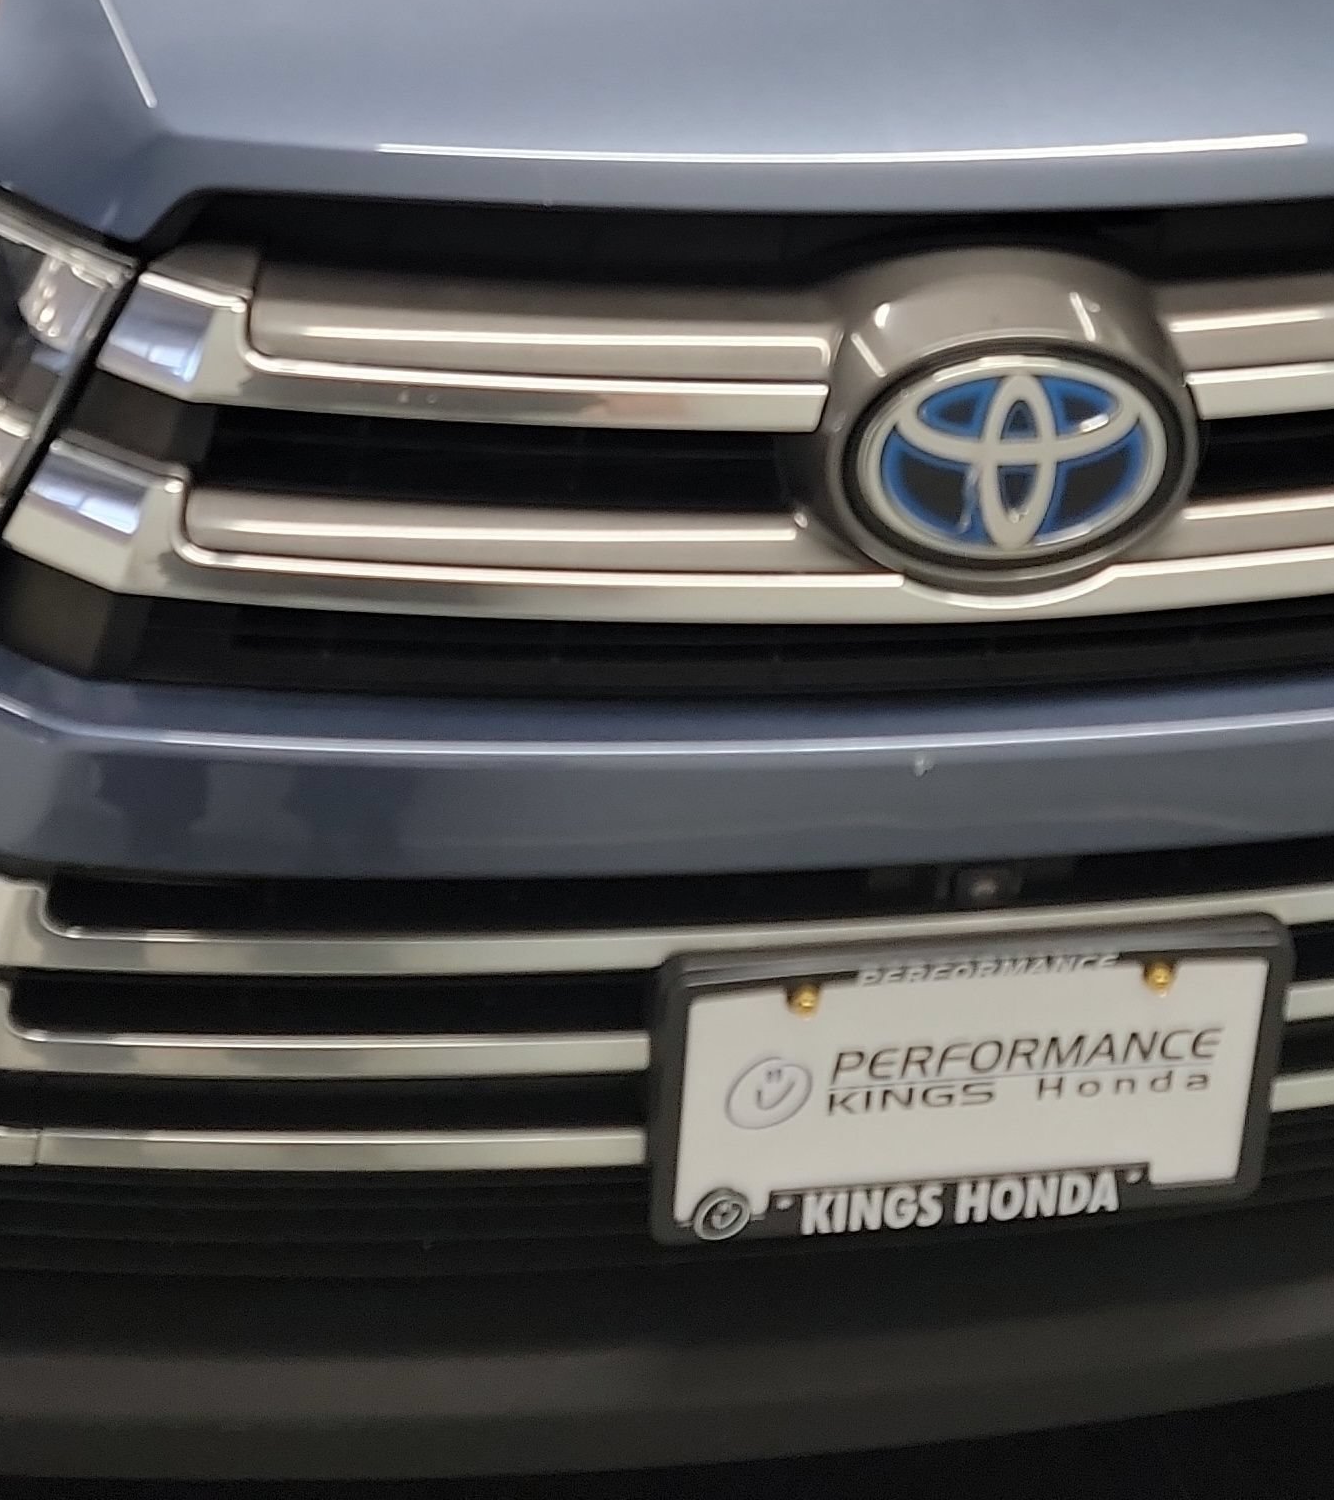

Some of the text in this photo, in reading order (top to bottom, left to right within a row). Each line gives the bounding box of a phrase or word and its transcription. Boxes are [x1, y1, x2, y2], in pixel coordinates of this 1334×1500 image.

[857, 951, 1119, 987] PERFORMANCE
[832, 1027, 1222, 1080] PERFORMANCE
[828, 1068, 1211, 1115] KINGS Honda
[800, 1168, 1119, 1236] KINGS HONDA
